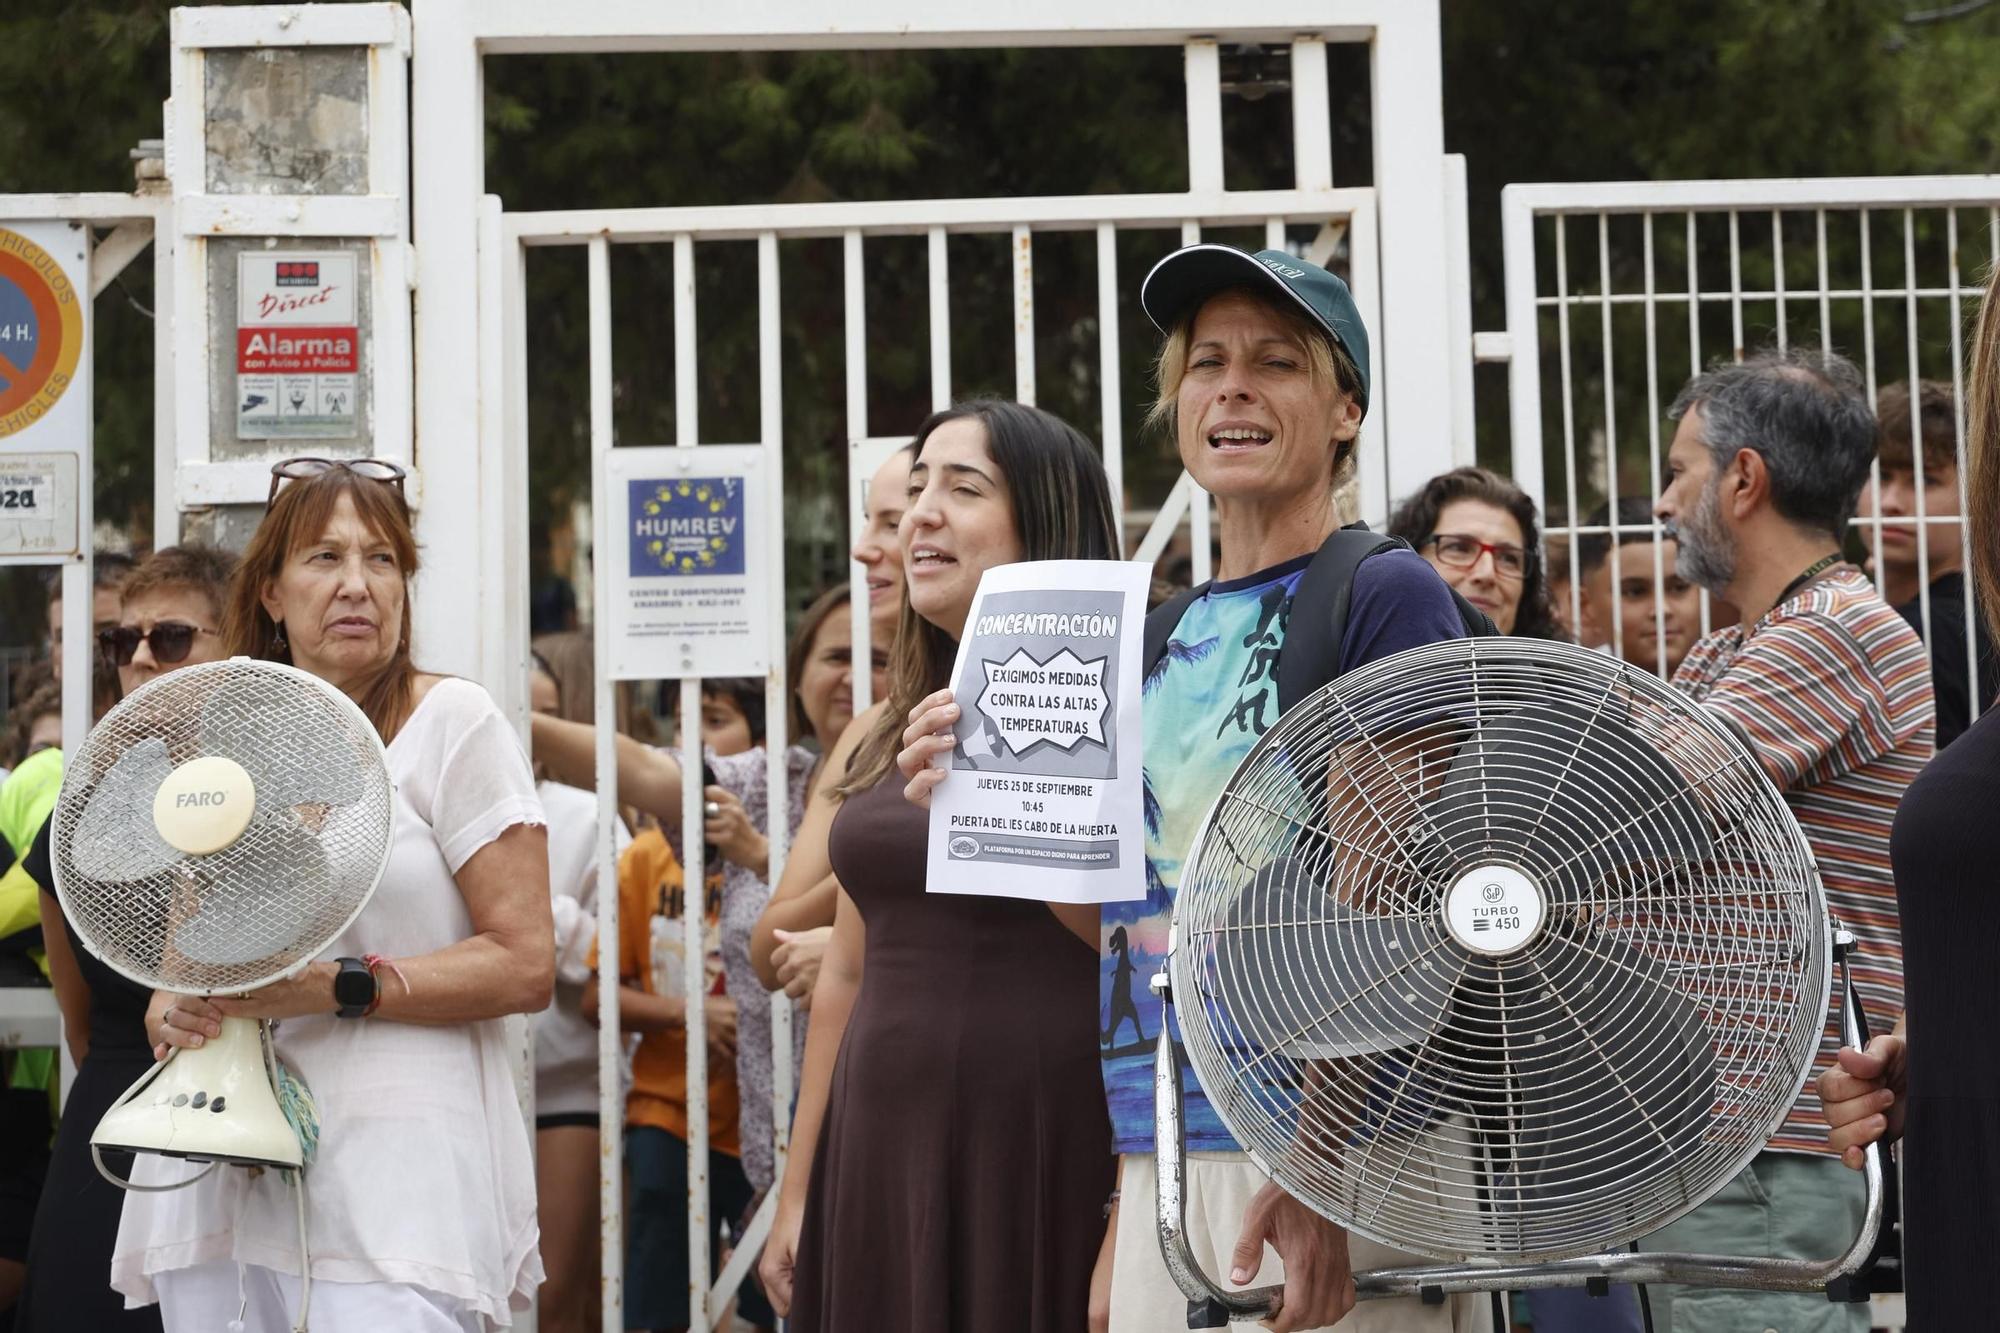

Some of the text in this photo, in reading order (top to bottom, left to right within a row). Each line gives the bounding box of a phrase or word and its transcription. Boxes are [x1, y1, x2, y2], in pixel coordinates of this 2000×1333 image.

[1, 231, 75, 304] HICULOS
[258, 285, 338, 318] Direct
[0, 324, 11, 341] 4
[245, 333, 351, 355] Alarma
[244, 359, 266, 368] con
[267, 357, 300, 368] Aviso
[303, 359, 311, 368] a
[636, 517, 736, 536] HUMREV
[629, 589, 669, 597] CENTRO
[975, 609, 1117, 638] CONCENTRACIÓN
[992, 669, 1098, 687] EXIGIMOS MEDIDAS
[990, 693, 1098, 711] CONTRA LAS ALTAS
[1000, 717, 1088, 735] TEMPERATURAS
[977, 778, 1093, 797] JUEVES 25 DE SEPTIEMBRE
[176, 791, 226, 808] FARO
[1022, 801, 1044, 813] 10:45
[951, 815, 1117, 837] PUERTA DEL IES CABO DE LA HUERTA
[984, 845, 1015, 854] PLATAFORMA
[1032, 849, 1050, 857] ESPACIO
[1067, 852, 1080, 860] PARA
[1486, 887, 1500, 900] S&P
[1472, 906, 1519, 917] TURBO
[1495, 916, 1520, 930] 450
